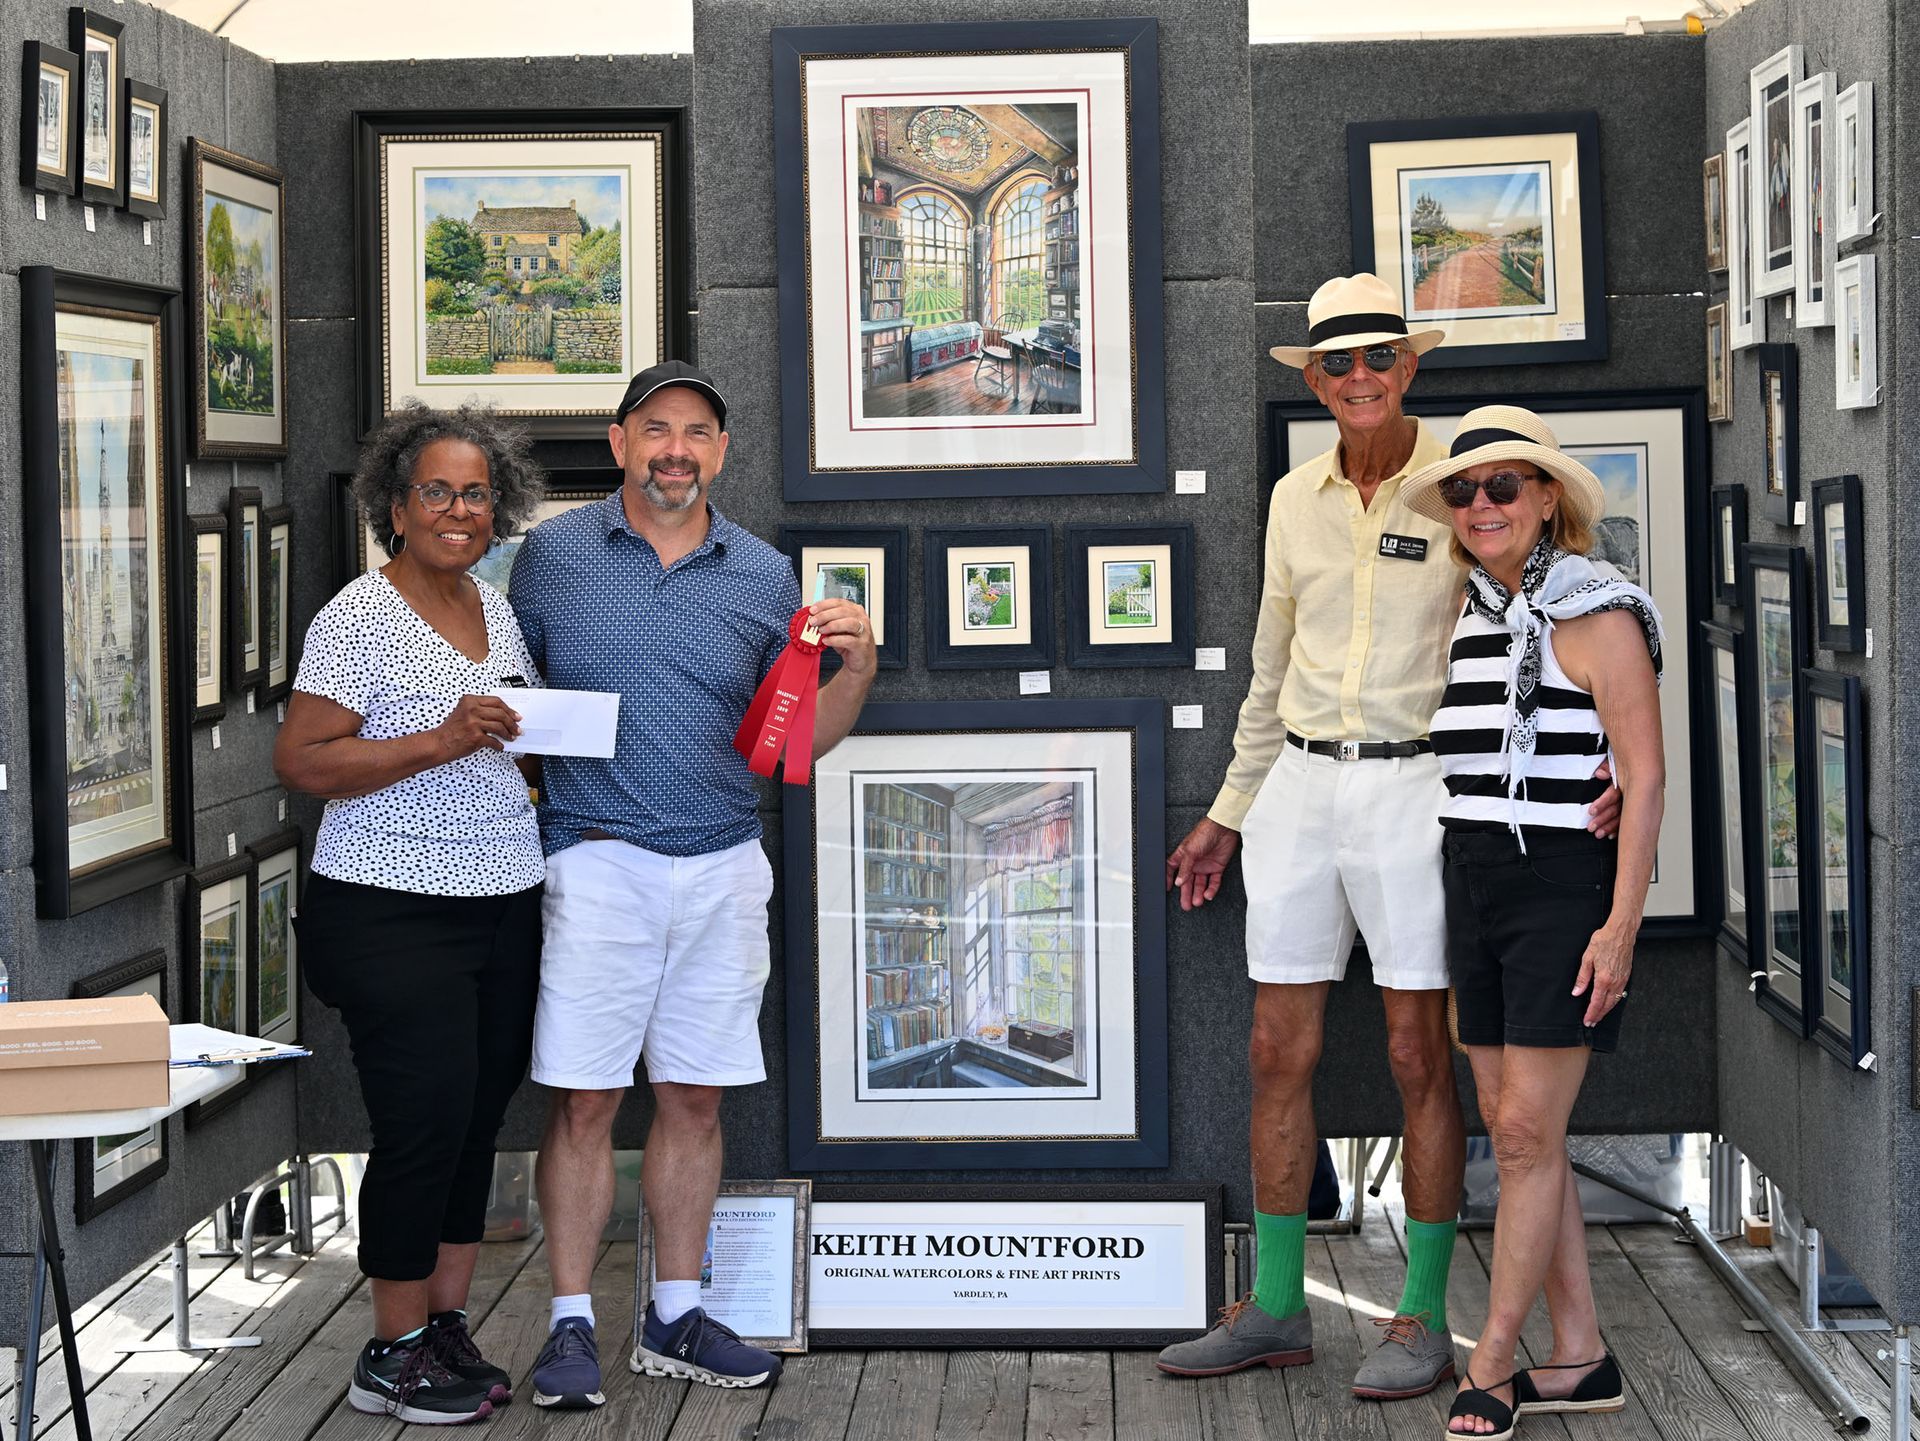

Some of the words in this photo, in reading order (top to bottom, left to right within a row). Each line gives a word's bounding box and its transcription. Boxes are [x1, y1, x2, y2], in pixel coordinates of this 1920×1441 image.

[811, 1234, 917, 1257] KEITH
[925, 1235, 1145, 1259] MOUNTFORD
[824, 1267, 890, 1278] ORIGINAL
[893, 1268, 993, 1279] WATERCOLORS
[996, 1269, 1005, 1279] &
[1009, 1269, 1040, 1280] FINE
[1042, 1269, 1069, 1280] ART
[1072, 1270, 1121, 1281] PRINTS
[953, 1291, 995, 1299] YARDLEY,
[997, 1291, 1008, 1299] PA
